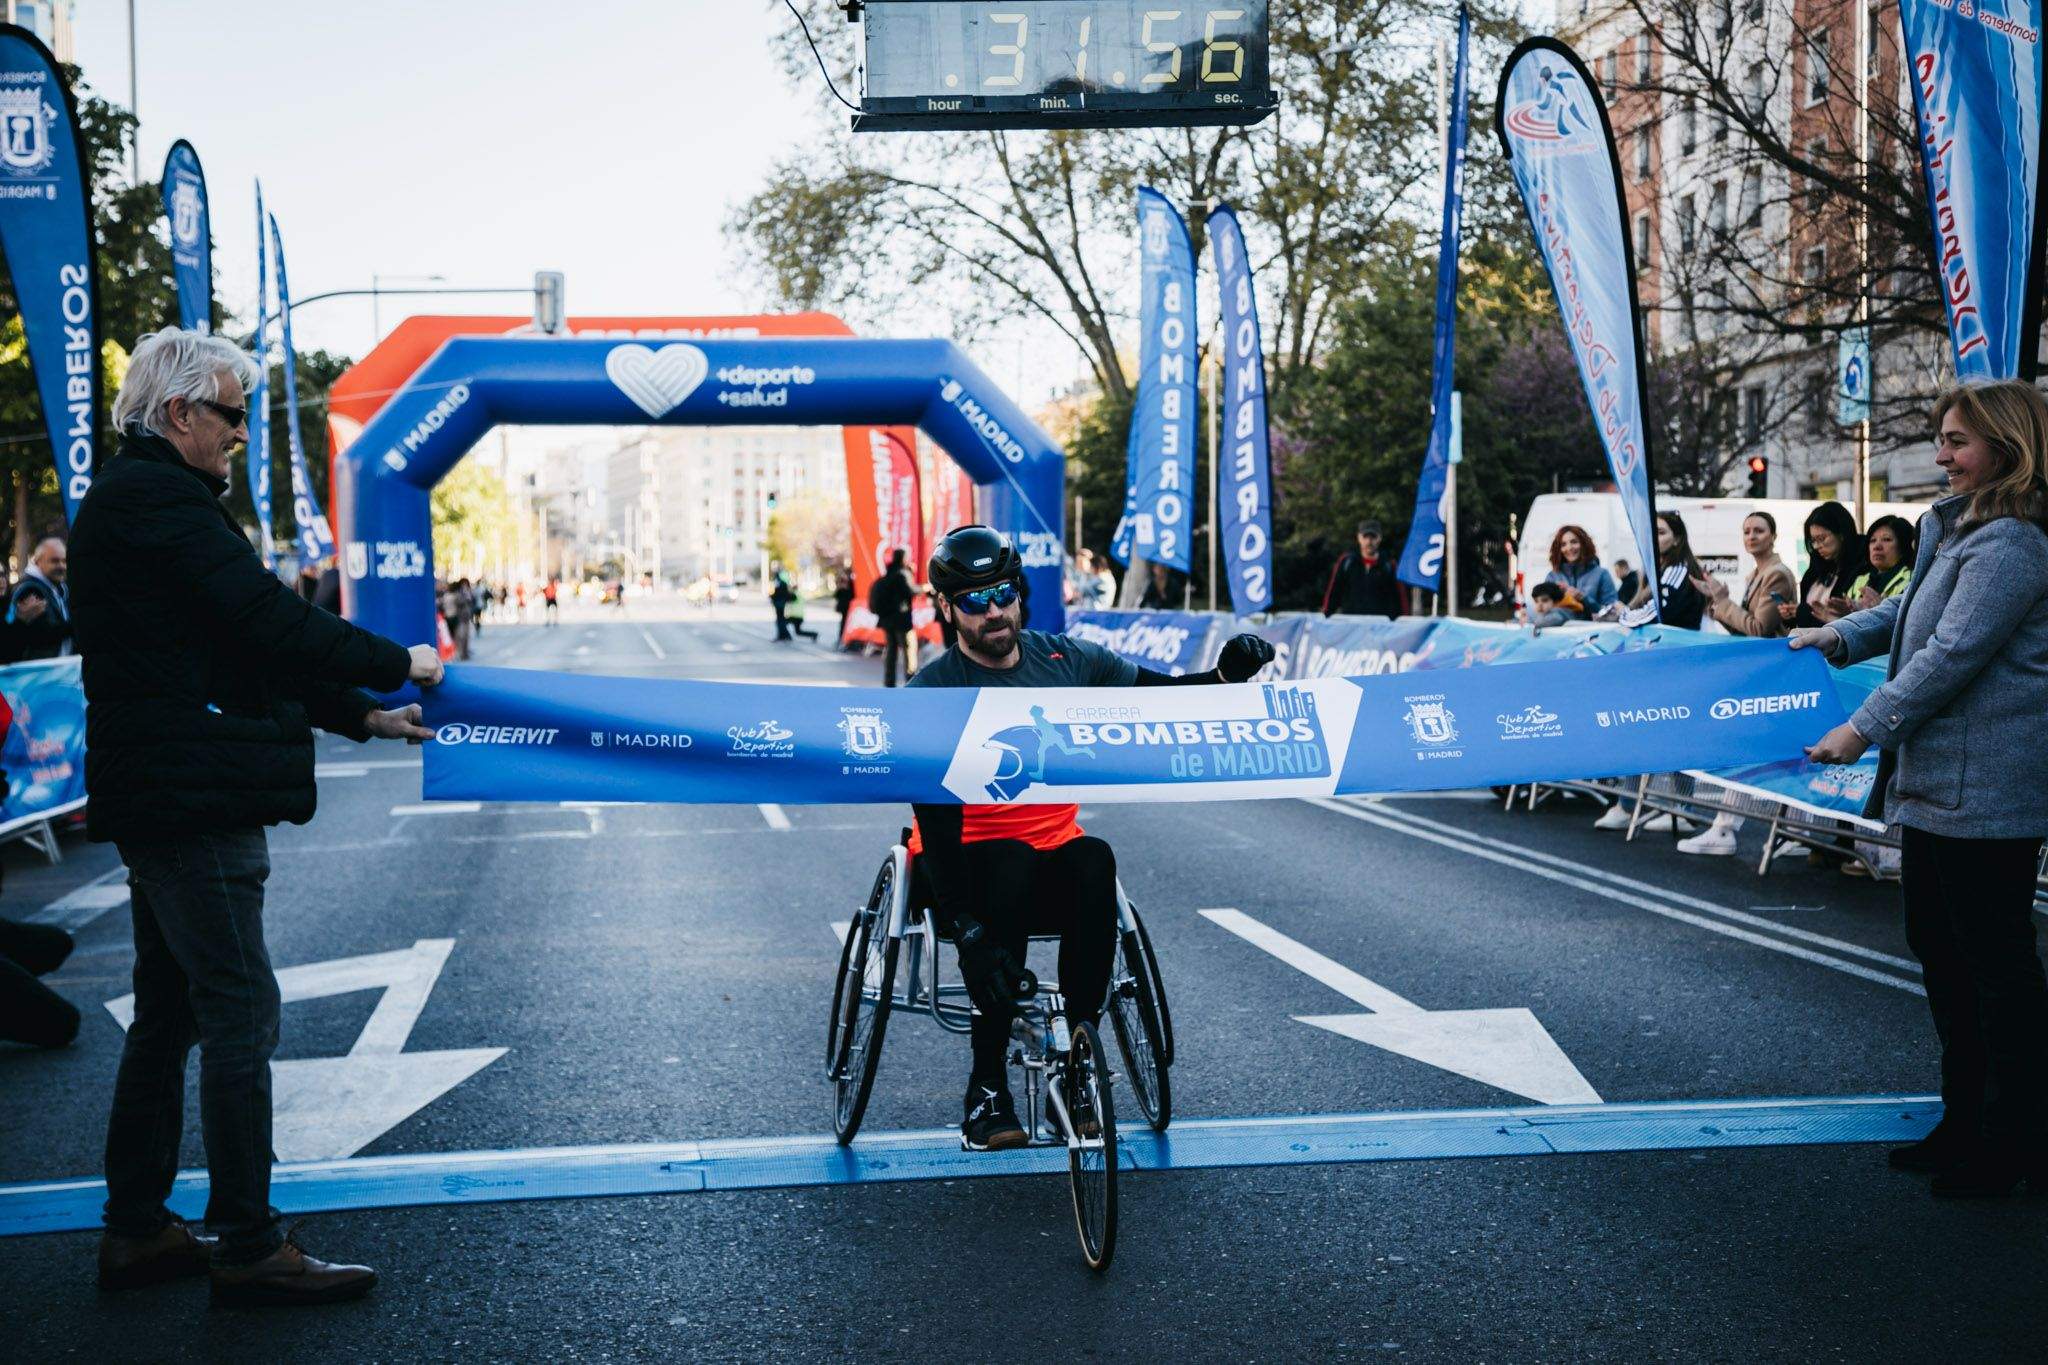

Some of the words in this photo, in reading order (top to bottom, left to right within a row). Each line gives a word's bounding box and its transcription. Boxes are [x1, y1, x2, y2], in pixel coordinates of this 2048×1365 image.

[928, 98, 962, 111] hour
[1040, 96, 1070, 109] min.
[1214, 92, 1243, 104] sec.
[403, 384, 470, 452] MADRID
[960, 399, 1024, 463] MADRID
[1404, 694, 1446, 703] BOMBEROS
[1740, 691, 1820, 716] ENERVIT
[840, 706, 884, 714] BOMBEROS
[1066, 706, 1141, 720] CARRERA
[1620, 706, 1690, 724] MADRID
[1496, 714, 1523, 724] Club
[727, 726, 757, 738] Club
[1069, 717, 1315, 746] BOMBEROS
[1504, 722, 1562, 734] Deportivo
[469, 725, 559, 745] ENERVIT
[616, 734, 692, 748] MADRID
[733, 738, 794, 753] Deportivo
[1170, 745, 1204, 778] de
[1212, 743, 1323, 776] MADRID
[1428, 750, 1462, 759] MADRID
[853, 766, 891, 774] MADRID
